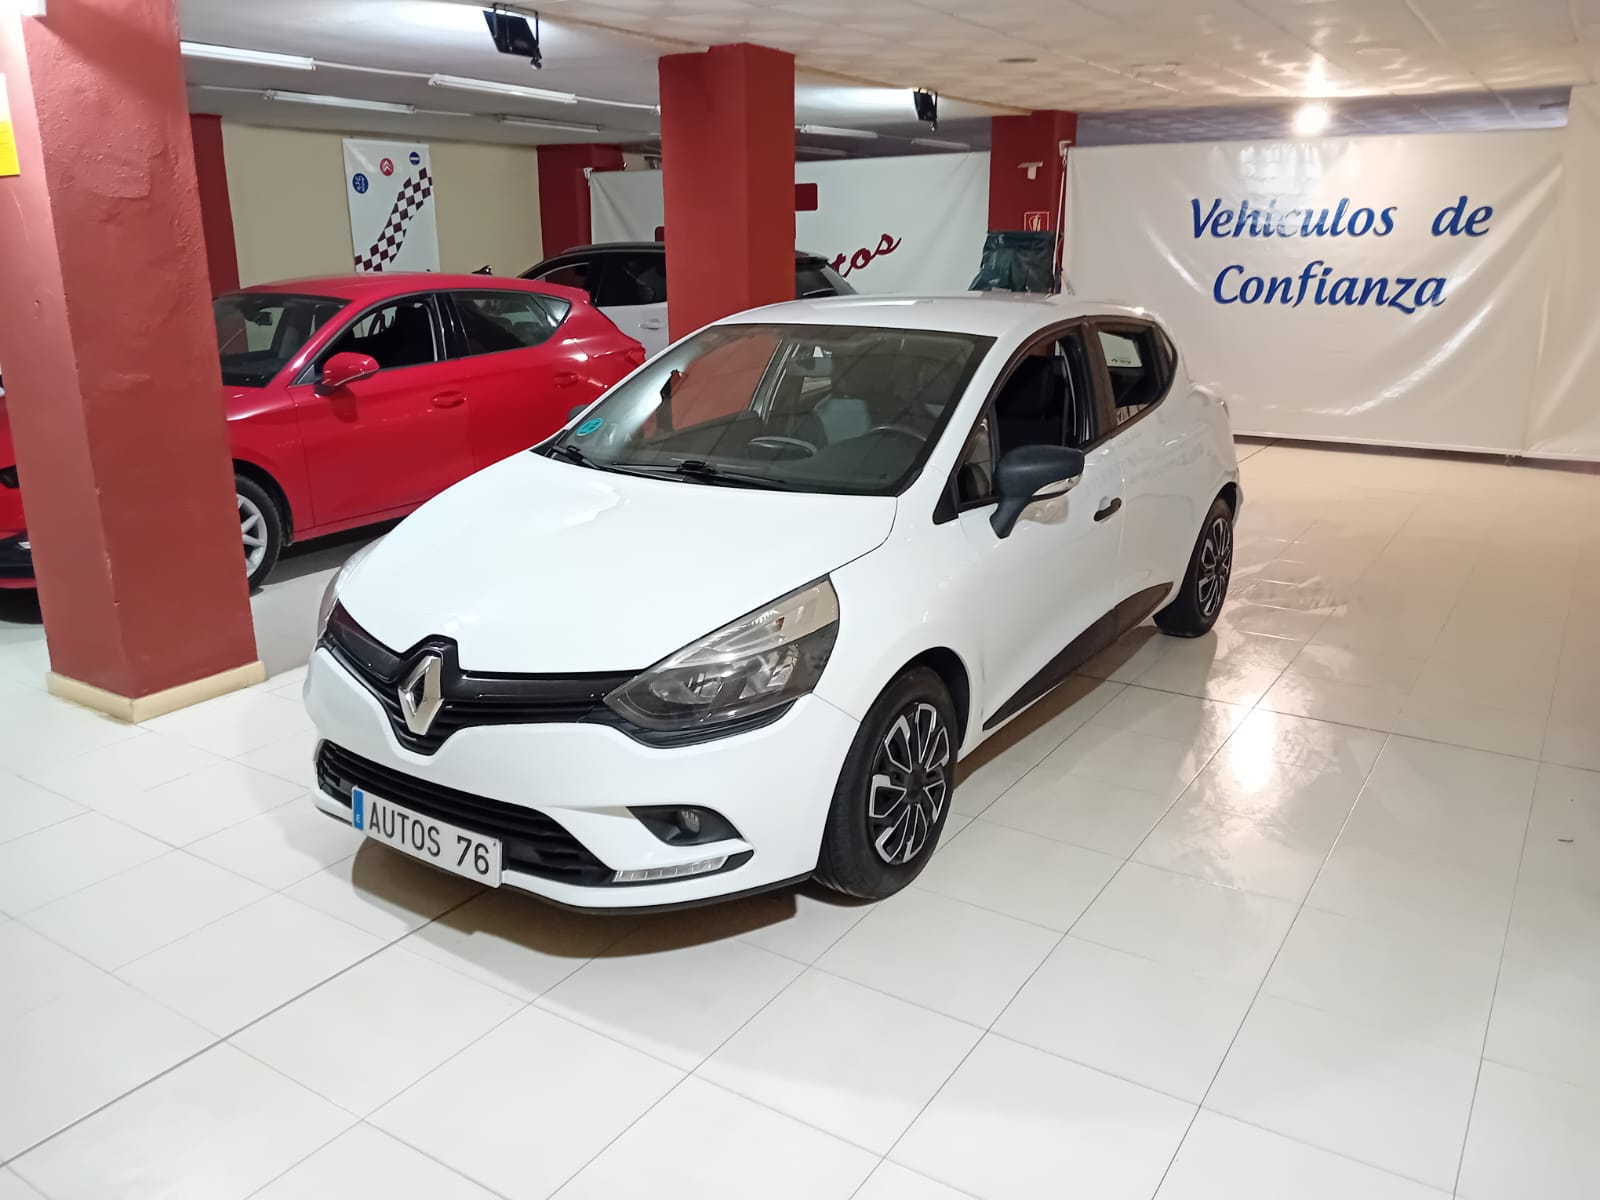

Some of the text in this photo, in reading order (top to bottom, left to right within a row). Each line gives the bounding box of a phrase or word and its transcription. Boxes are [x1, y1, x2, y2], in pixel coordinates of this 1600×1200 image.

[1431, 195, 1493, 237] de
[831, 233, 902, 278] tos
[1213, 260, 1447, 314] Confianza
[369, 801, 490, 875] AUTOS 76
